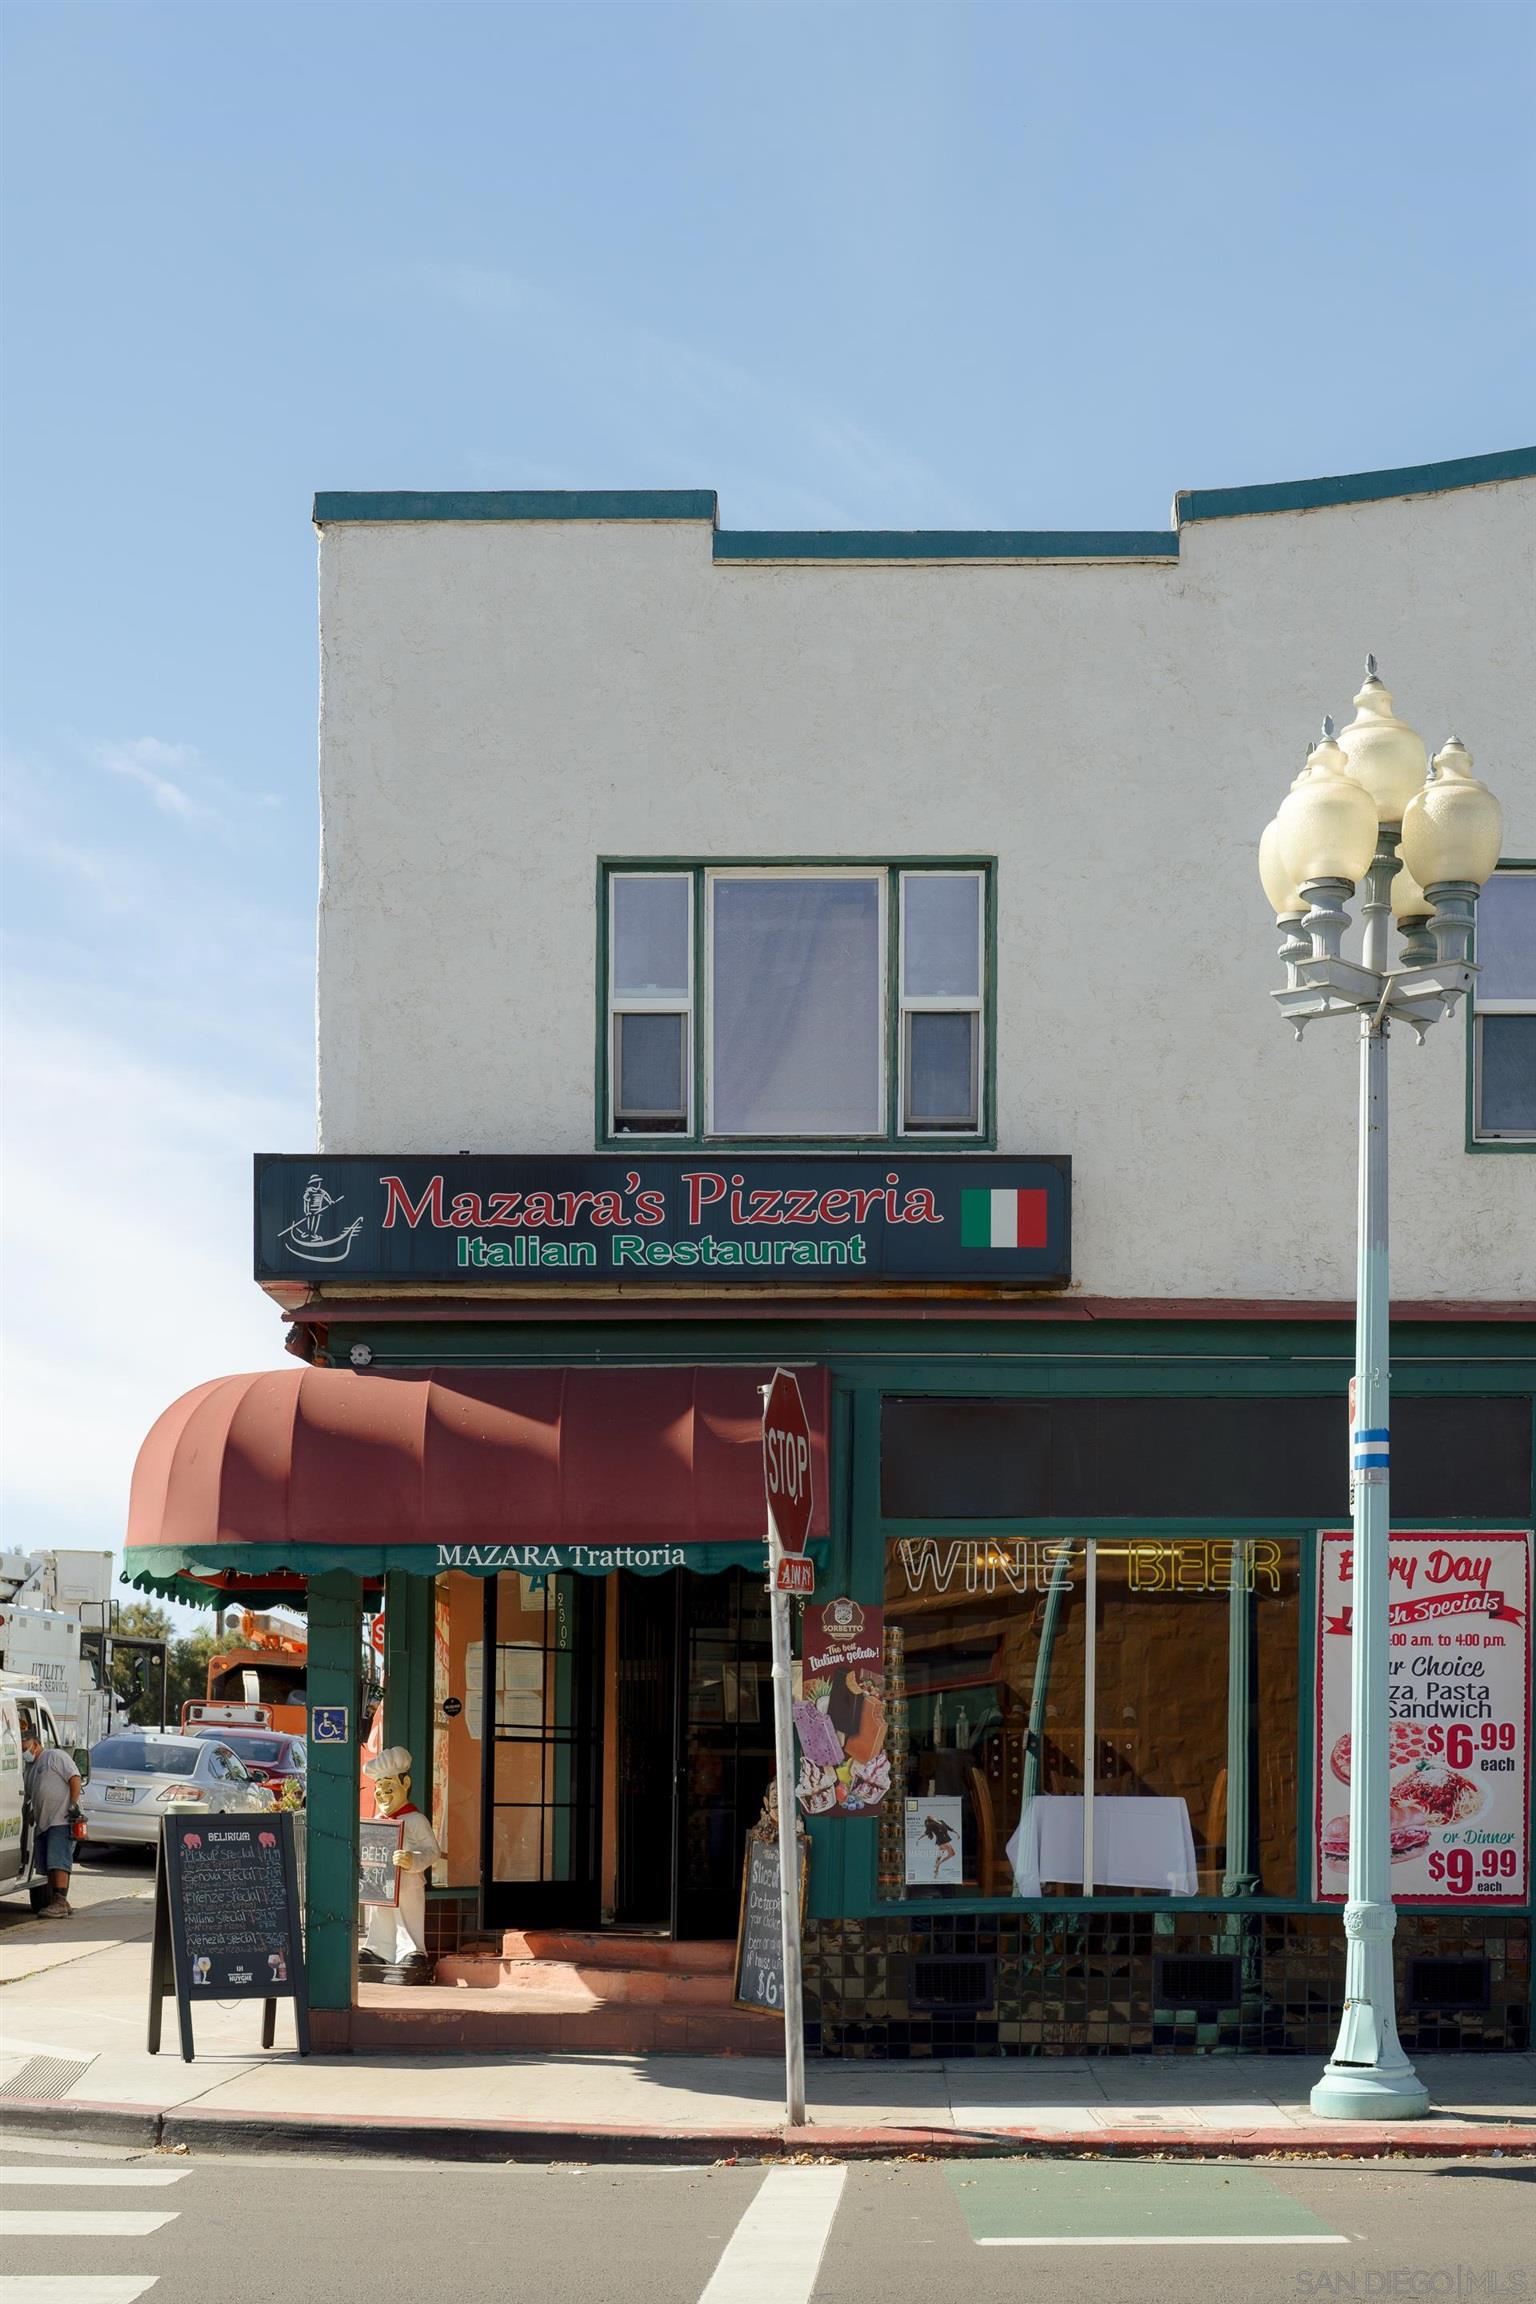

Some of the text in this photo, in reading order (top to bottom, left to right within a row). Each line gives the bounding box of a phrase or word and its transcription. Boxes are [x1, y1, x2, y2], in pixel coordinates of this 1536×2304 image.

[379, 1171, 944, 1229] Mazara's Pizzeria
[457, 1234, 867, 1267] Italian Restaurant
[768, 1427, 807, 1498] STOP
[437, 1544, 686, 1567] MAZARA Trattoria
[899, 1538, 1074, 1592] WINE
[1128, 1538, 1281, 1592] BEER
[1338, 1549, 1492, 1589] Ery Day
[1414, 1592, 1500, 1621] Specials
[826, 1642, 857, 1654] The best
[1389, 1634, 1405, 1647] :00
[1438, 1634, 1452, 1647] to
[1455, 1634, 1478, 1647] 4:00
[1483, 1635, 1506, 1649] p.m.
[808, 1647, 879, 1672] Italian gelato!
[1388, 1655, 1485, 1678] ur Choice
[31, 1663, 66, 1681] UTILITY
[44, 1681, 69, 1692] SERVICE
[1389, 1682, 1489, 1701] za, Pasta
[1427, 1723, 1515, 1770] $6.99
[1481, 1757, 1515, 1771] each
[1443, 1829, 1515, 1845] or Dinner
[361, 1846, 388, 1863] BEER
[1428, 1848, 1516, 1894] $9.99
[1477, 1880, 1502, 1892] each
[764, 1893, 781, 1917] toppi
